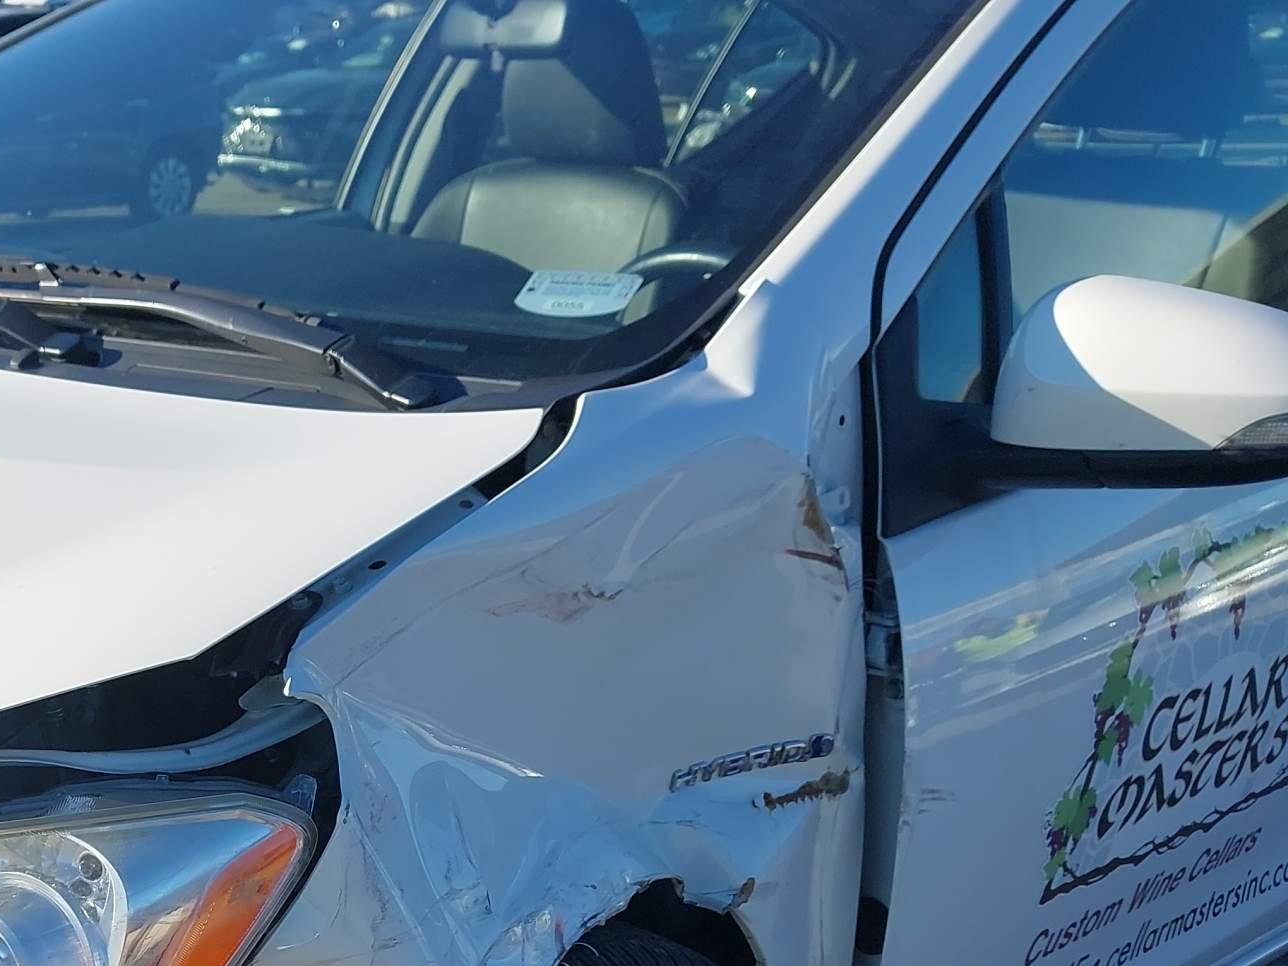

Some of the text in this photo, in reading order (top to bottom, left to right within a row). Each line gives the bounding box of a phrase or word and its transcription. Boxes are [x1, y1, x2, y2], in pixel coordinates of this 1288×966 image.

[669, 739, 809, 793] HYBRID
[1142, 654, 1288, 762] CELLAR
[1098, 714, 1288, 840] MASTERS
[1024, 827, 1262, 966] Custom Wine Cellars
